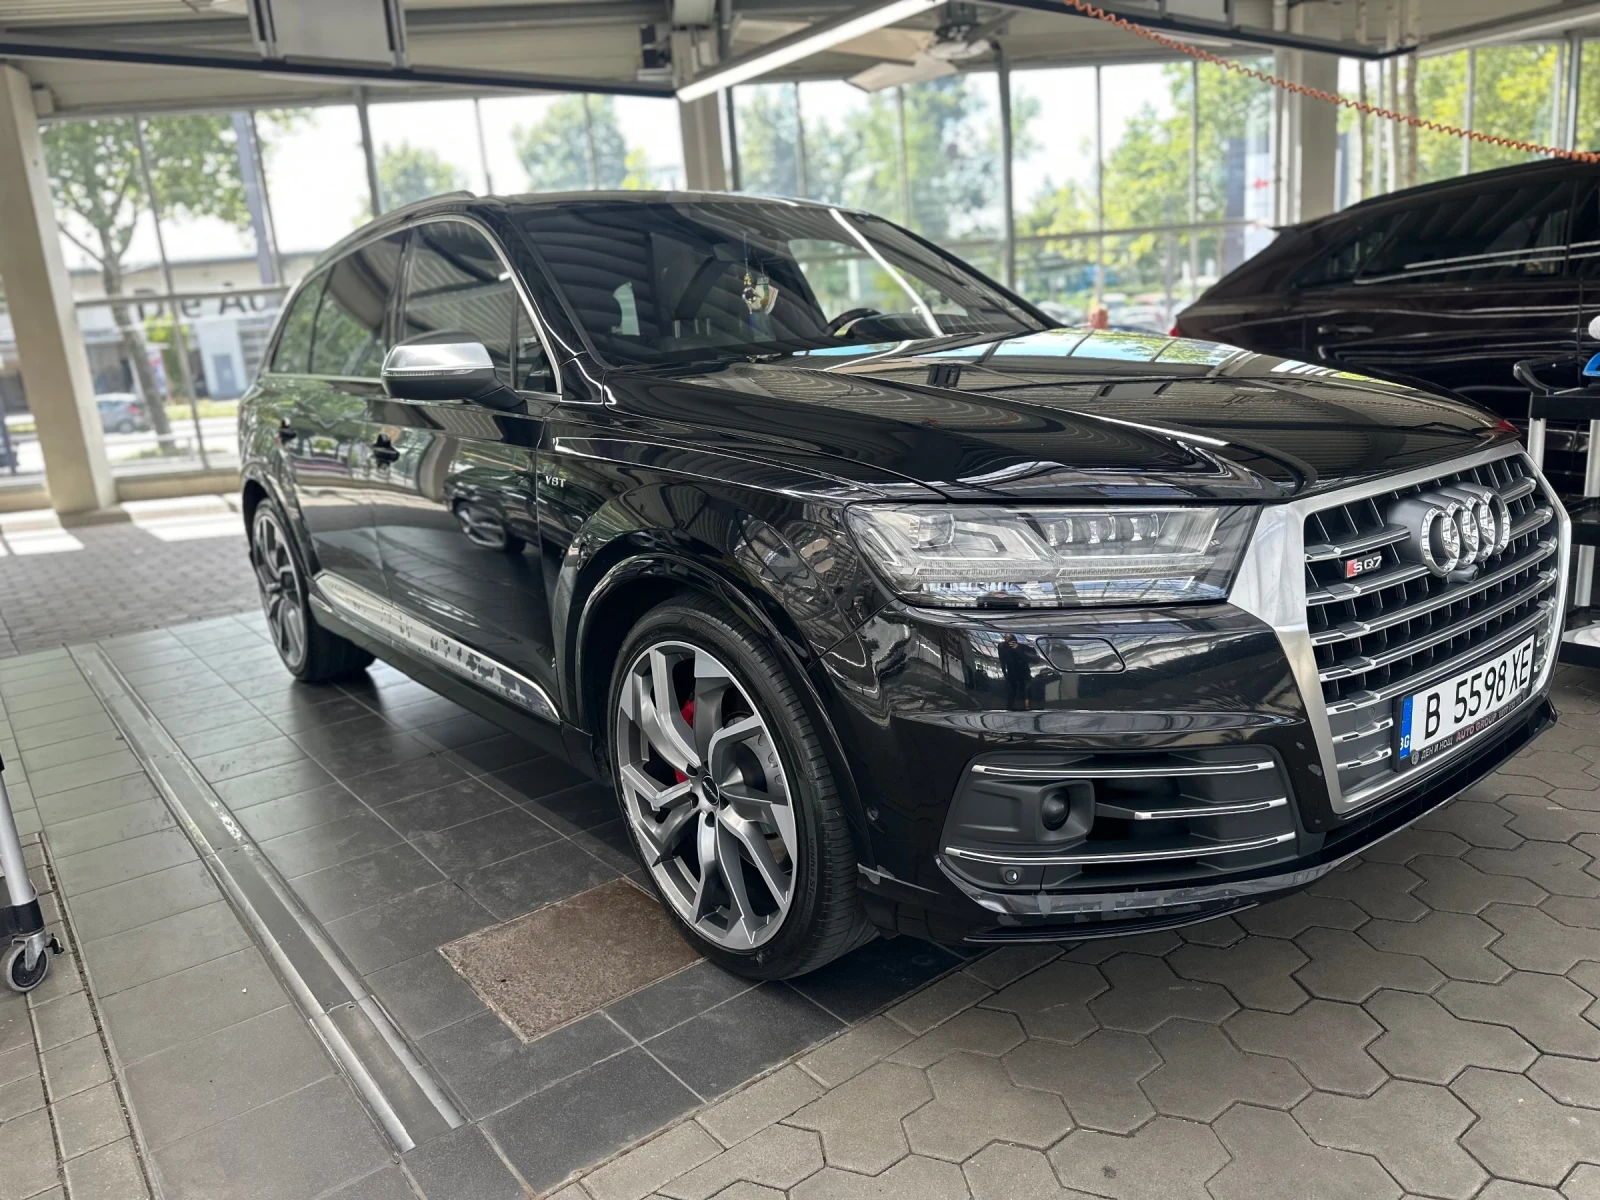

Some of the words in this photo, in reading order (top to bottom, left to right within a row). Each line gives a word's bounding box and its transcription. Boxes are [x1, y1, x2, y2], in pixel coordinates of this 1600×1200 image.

[545, 475, 567, 488] V8T
[1353, 555, 1382, 573] SQ7
[1424, 692, 1441, 740] B
[1453, 660, 1507, 724] 5598
[1509, 644, 1531, 695] XE
[1455, 726, 1475, 742] AUTO
[1475, 714, 1497, 731] GROUP
